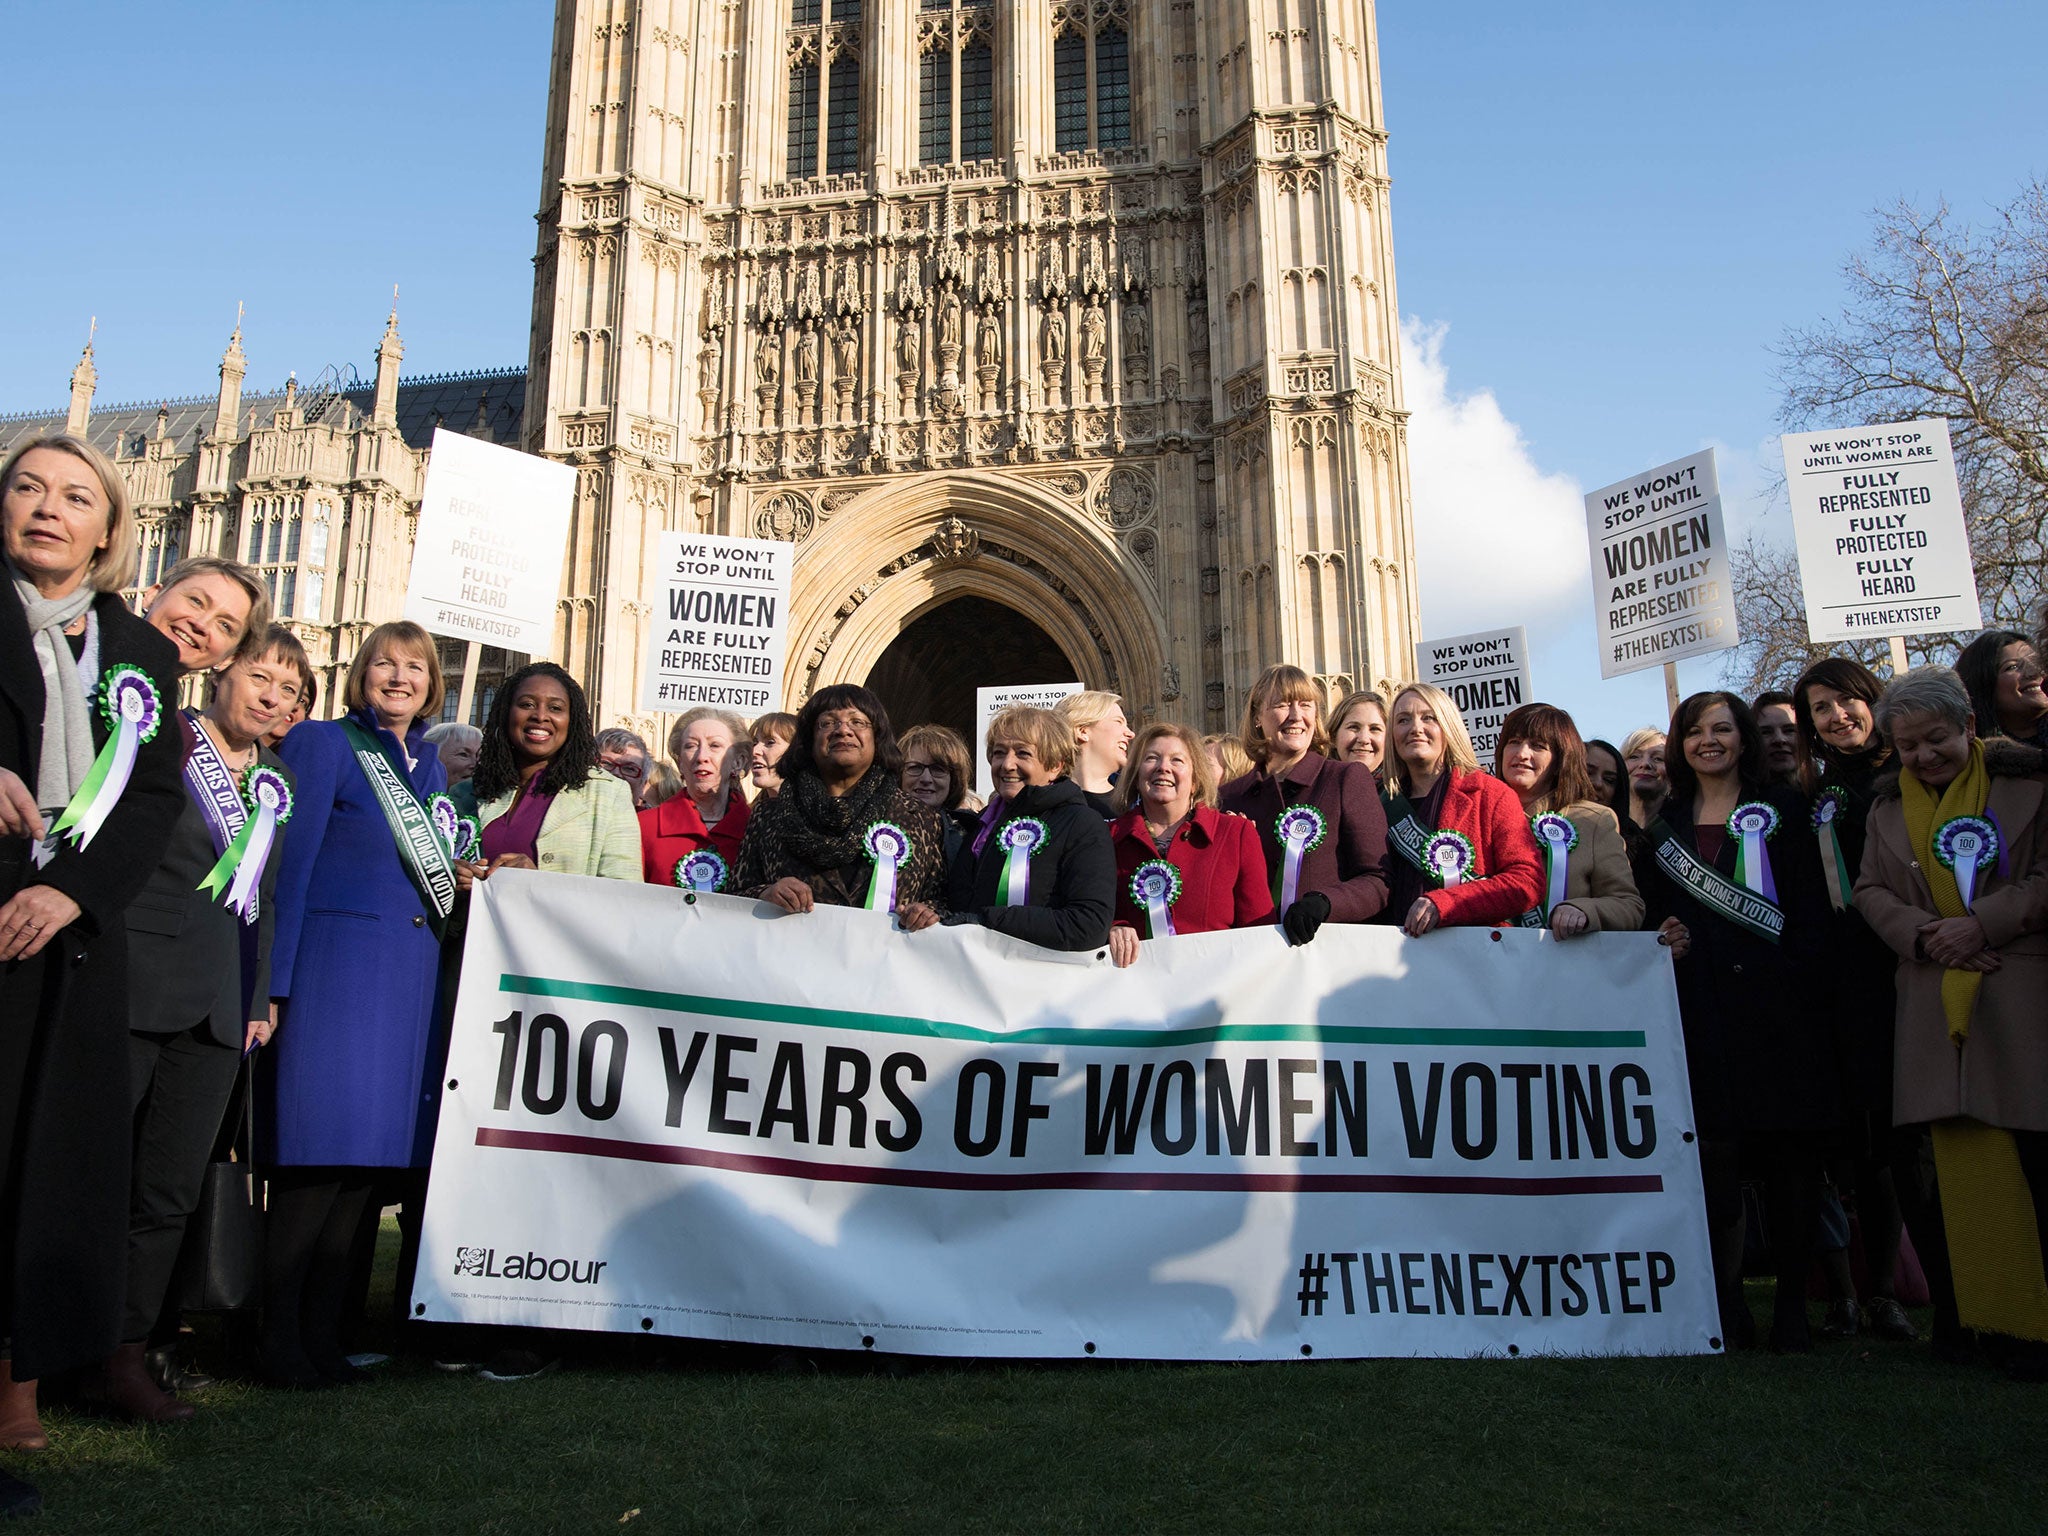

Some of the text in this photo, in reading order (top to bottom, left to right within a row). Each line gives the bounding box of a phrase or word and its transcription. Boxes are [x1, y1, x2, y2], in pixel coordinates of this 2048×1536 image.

[1810, 433, 1922, 453] WE WON'T STOP
[1804, 446, 1933, 468] UNTIL WOMEN ARE
[1603, 466, 1696, 511] WE WON'T
[1842, 472, 1900, 490] FULLY
[1604, 485, 1701, 530] STOP UNTIL
[1818, 486, 1931, 514] REPRESENTED
[1849, 514, 1907, 532] FULLY
[680, 544, 775, 564] WE WON'T
[1602, 513, 1711, 580] WOMEN
[1836, 530, 1928, 555] PROTECTED
[451, 539, 530, 574] PROTECTED
[1856, 557, 1914, 575] FULLY
[462, 566, 512, 590] FULLY
[676, 561, 775, 581] STOP UNTIL
[1610, 557, 1712, 603] ARE FULLY
[460, 584, 507, 609] HEARD
[1861, 575, 1916, 597] HEARD
[669, 588, 776, 628] WOMEN
[1609, 580, 1720, 630] REPRESENTED
[1845, 606, 1942, 627] #THENEXTSTEP
[437, 609, 521, 638] #THENEXTSTEP
[667, 628, 771, 650] ARE FULLY
[1432, 638, 1510, 660] WE WON'T
[1613, 616, 1723, 663] #THENEXTSTEP
[661, 650, 772, 676] REPRESENTED
[1433, 653, 1514, 675] STOP UNTIL
[658, 682, 770, 707] #THENEXTSTEP
[192, 743, 229, 790] YEARS
[216, 792, 239, 811] OF
[381, 772, 412, 806] YEARS
[399, 804, 423, 825] OF
[1746, 819, 1760, 827] 100
[1017, 834, 1031, 842] 100
[1294, 824, 1307, 833] 100
[1547, 828, 1560, 837] 100
[408, 823, 441, 875] WOMEN
[881, 839, 894, 851] 100
[1441, 850, 1454, 860] 100
[1959, 838, 1975, 849] 100
[695, 867, 709, 877] 100
[1149, 880, 1161, 891] 100
[1657, 840, 1784, 931] 100 YEARS OF WOMEN VOTING
[492, 1010, 1657, 1161] 100 YEARS OF WOMEN VOTING
[485, 1248, 608, 1285] Labour
[1297, 1250, 1676, 1317] #THENEXTSTEP
